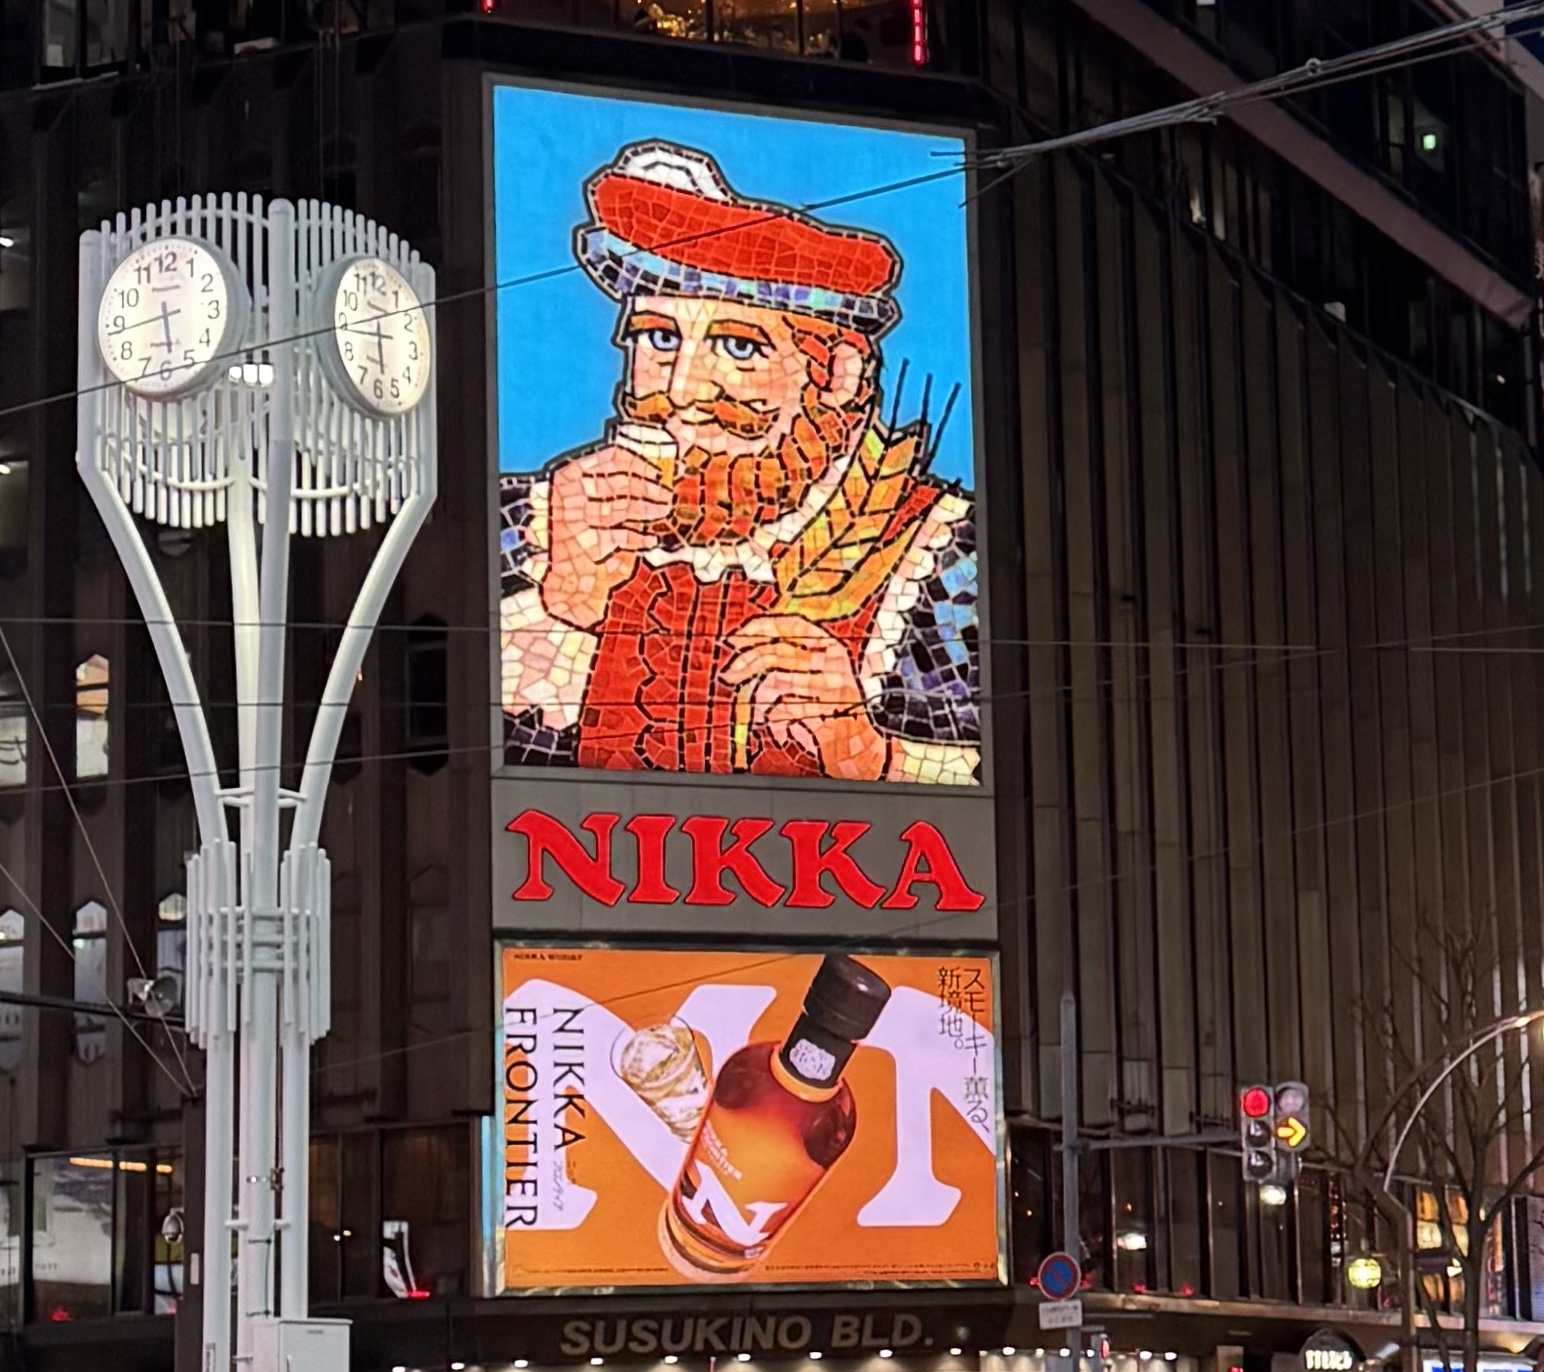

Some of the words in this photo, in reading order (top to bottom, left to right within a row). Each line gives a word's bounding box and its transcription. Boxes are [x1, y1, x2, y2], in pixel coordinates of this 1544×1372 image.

[155, 252, 177, 273] 12
[186, 257, 194, 277] 1
[134, 265, 151, 285] 11
[201, 273, 214, 293] 2
[354, 274, 367, 295] 11
[370, 271, 387, 296] 12
[119, 288, 139, 308] 10
[344, 290, 358, 311] 10
[392, 290, 399, 310] 1
[207, 300, 220, 319] 3
[113, 315, 126, 332] 9
[404, 313, 414, 332] 2
[199, 328, 211, 347] 4
[121, 341, 133, 360] 8
[183, 349, 196, 368] 5
[344, 342, 354, 361] 8
[408, 342, 418, 361] 3
[138, 357, 152, 378] 7
[160, 361, 172, 381] 6
[357, 366, 368, 385] 7
[403, 366, 412, 385] 4
[373, 380, 384, 400] 6
[390, 379, 400, 399] 5
[506, 808, 987, 912] NIKKA
[552, 1007, 586, 1152] NIKKA
[504, 1006, 539, 1229] FRONTIER
[560, 1314, 813, 1356] SUSUKINO
[830, 1313, 934, 1349] BLD.
